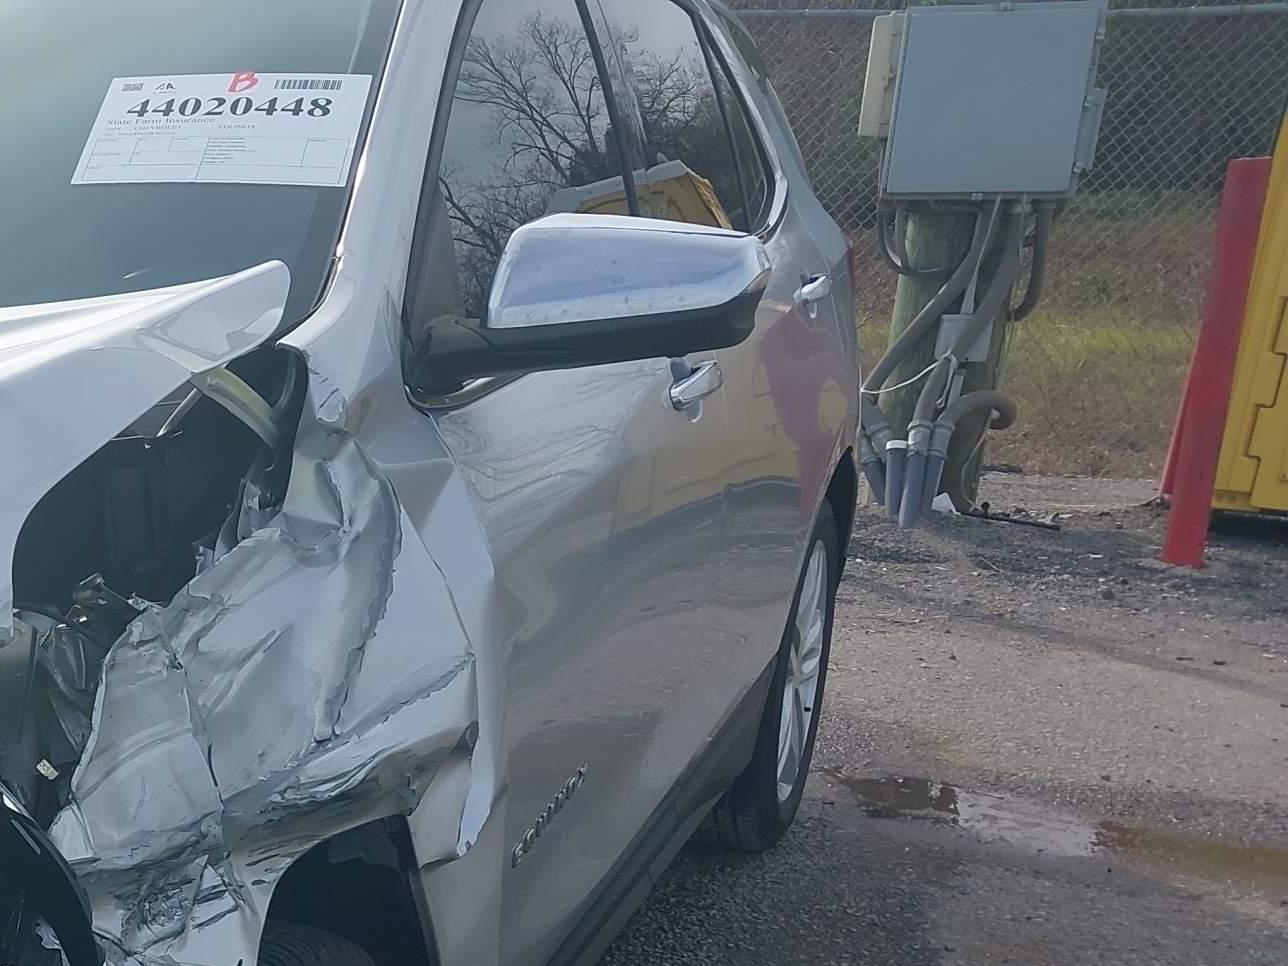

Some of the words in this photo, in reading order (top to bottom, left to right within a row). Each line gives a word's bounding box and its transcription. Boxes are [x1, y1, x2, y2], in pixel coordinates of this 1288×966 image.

[227, 70, 259, 93] B
[126, 97, 333, 118] 44020448
[106, 118, 132, 126] State
[165, 116, 216, 125] Insurance
